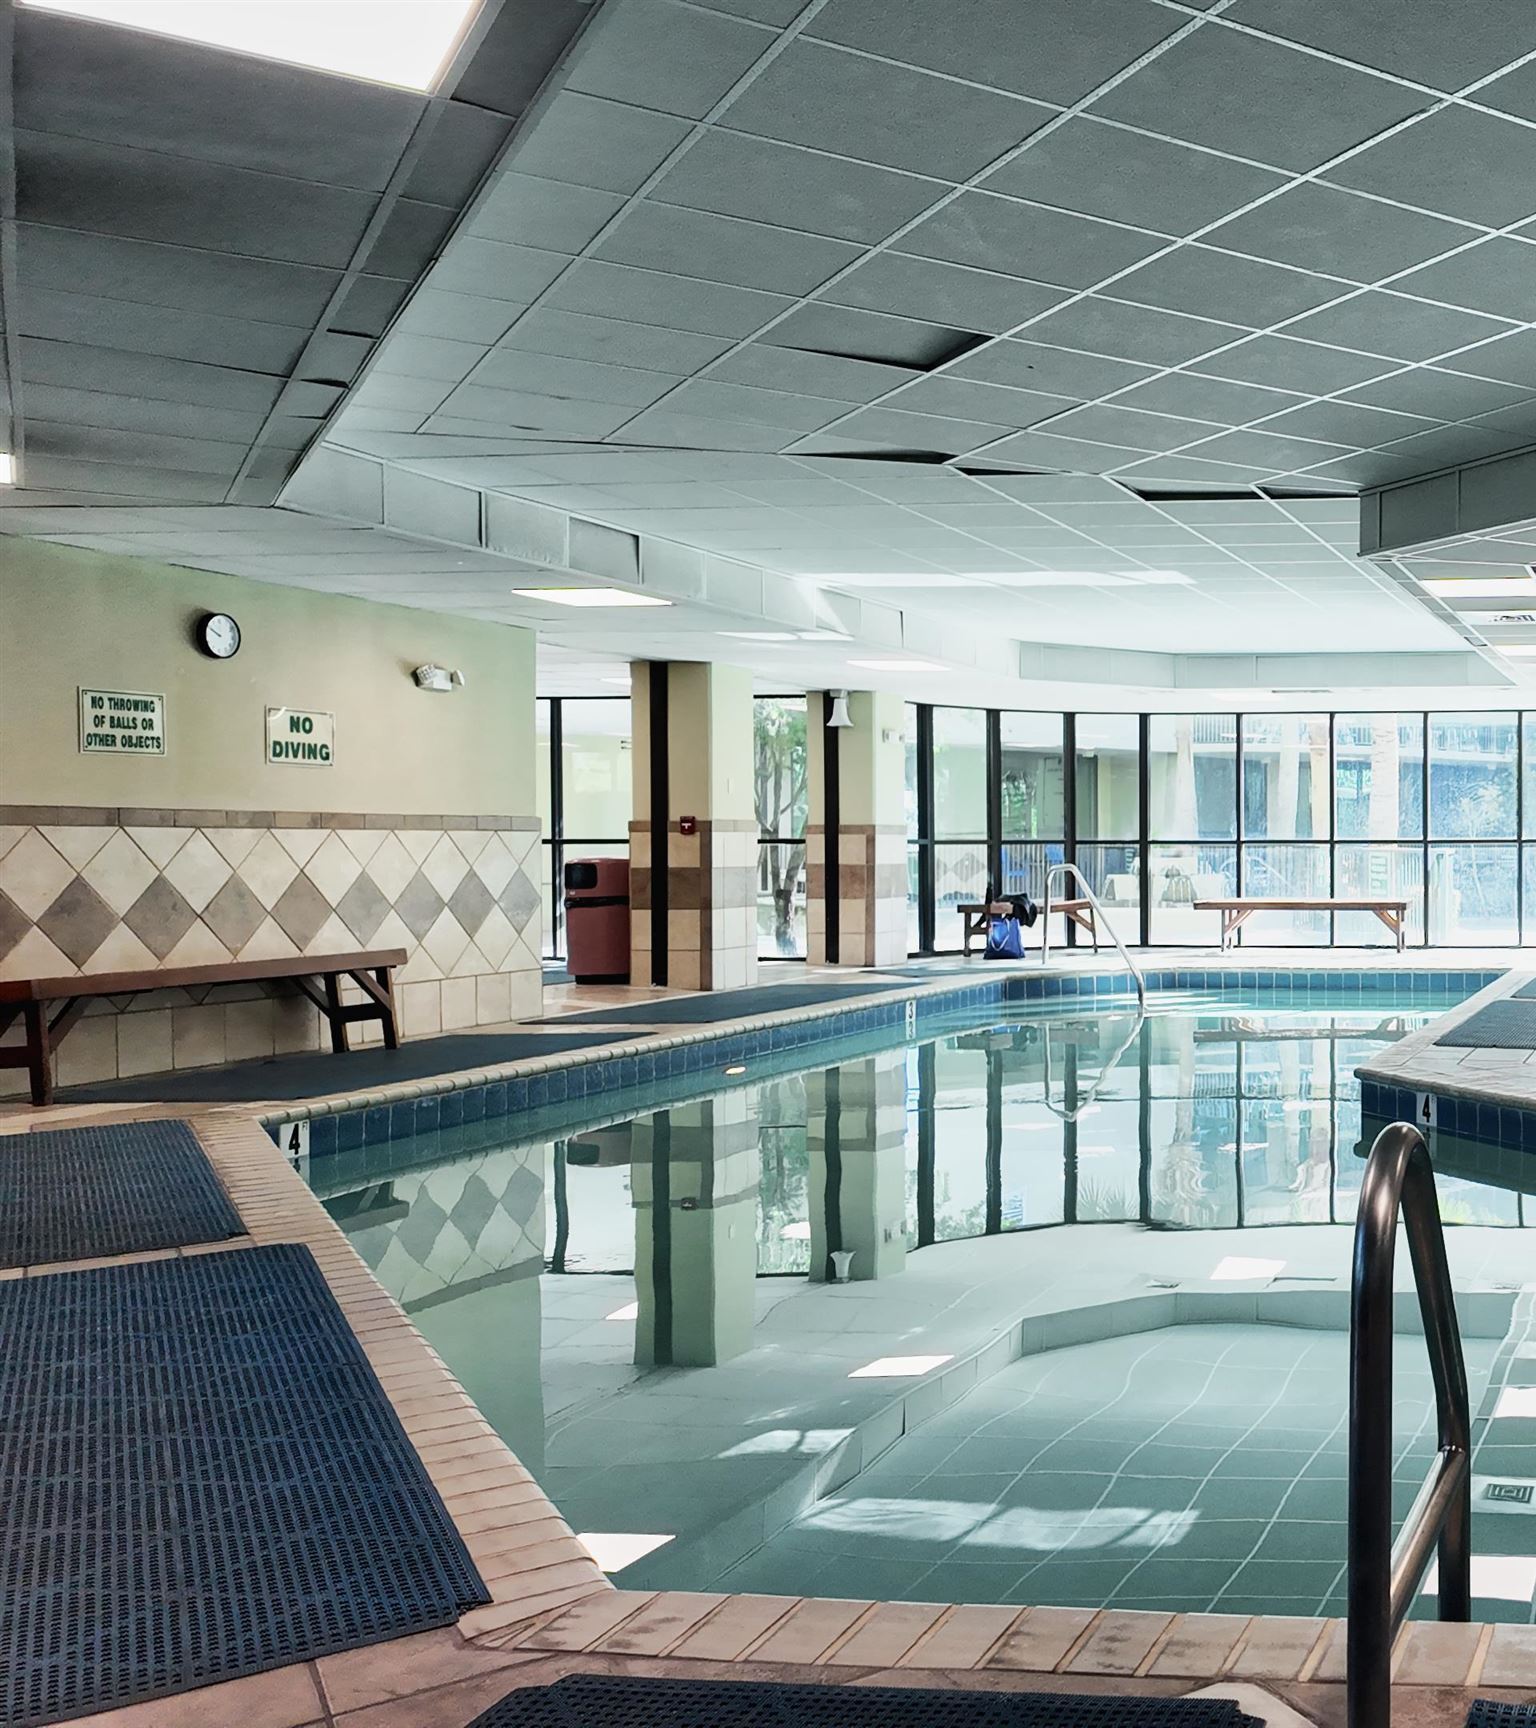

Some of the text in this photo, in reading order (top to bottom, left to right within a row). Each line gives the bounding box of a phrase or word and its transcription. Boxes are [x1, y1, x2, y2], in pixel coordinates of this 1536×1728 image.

[91, 696, 155, 713] NO THROWING
[93, 715, 154, 731] OF BALLS OR
[289, 715, 313, 734] NO
[86, 733, 161, 749] OTHER OBJECTS
[272, 740, 330, 761] DIVING
[1422, 1094, 1431, 1123] 4
[288, 1123, 301, 1155] 4
